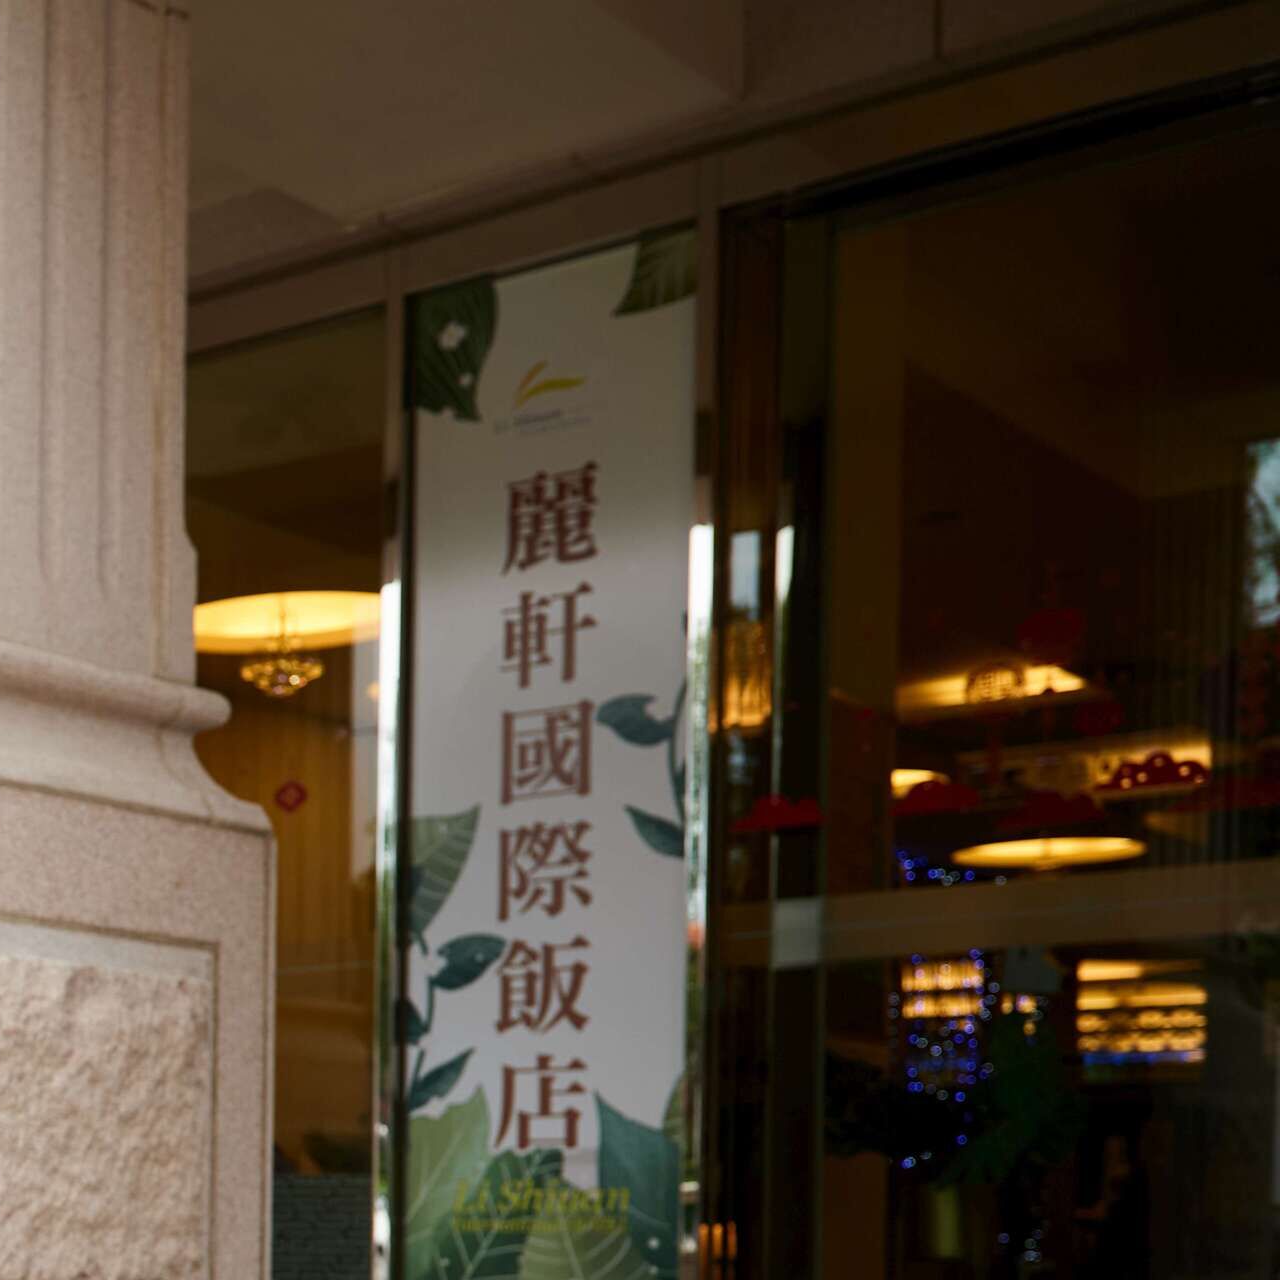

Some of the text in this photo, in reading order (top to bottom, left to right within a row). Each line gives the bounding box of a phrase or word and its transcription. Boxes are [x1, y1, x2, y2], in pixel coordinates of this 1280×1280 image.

[495, 460, 598, 1150] 麗軒國際飯店
